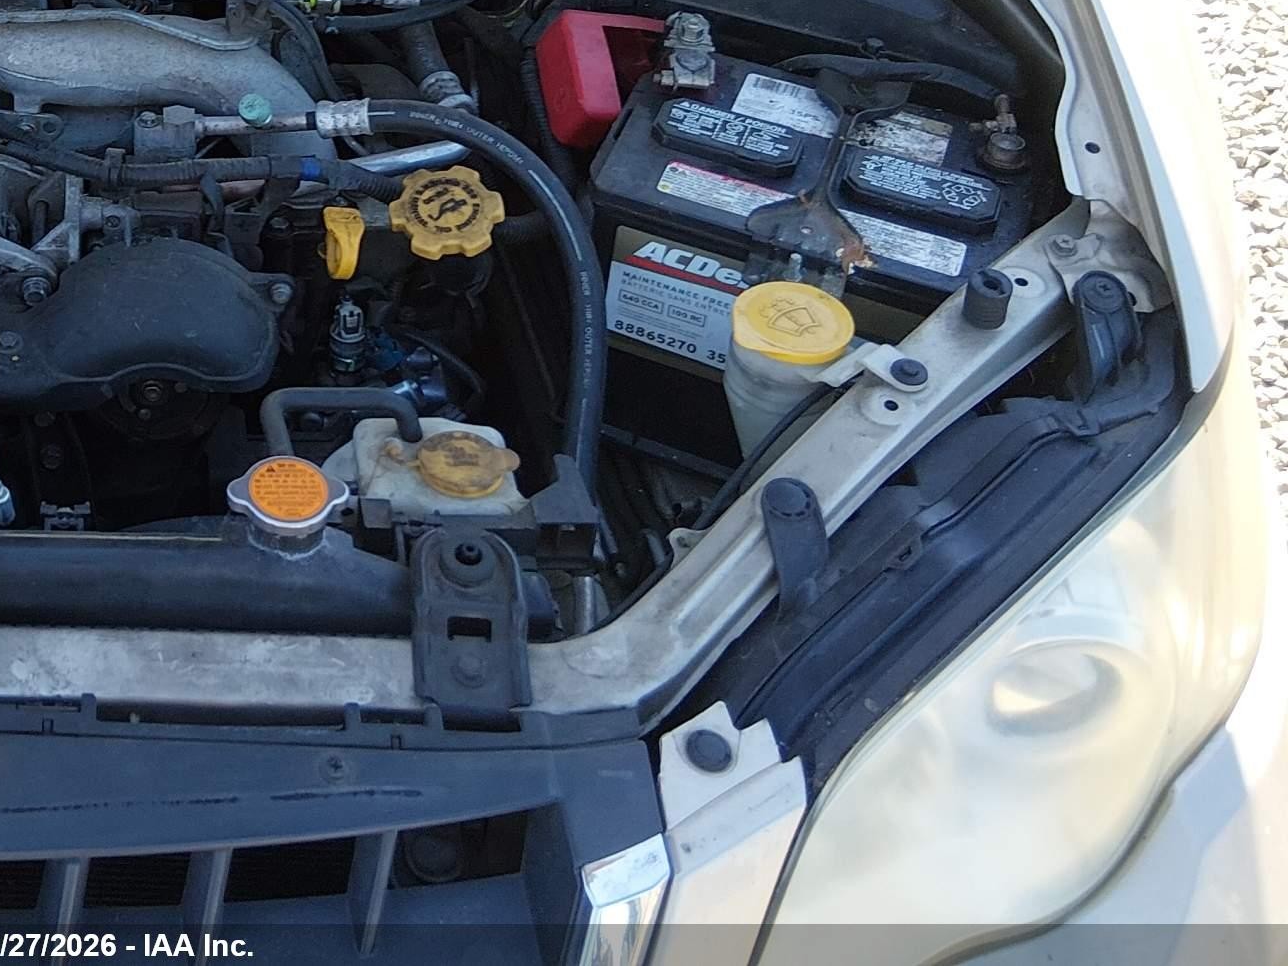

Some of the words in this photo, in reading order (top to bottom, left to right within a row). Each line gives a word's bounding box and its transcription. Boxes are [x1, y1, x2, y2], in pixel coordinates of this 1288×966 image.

[632, 240, 750, 290] ACDe
[622, 270, 699, 300] MAINTENANCE
[702, 295, 732, 310] FREE
[640, 298, 660, 310] CCA
[614, 319, 698, 354] 88865270
[706, 349, 727, 364] 35
